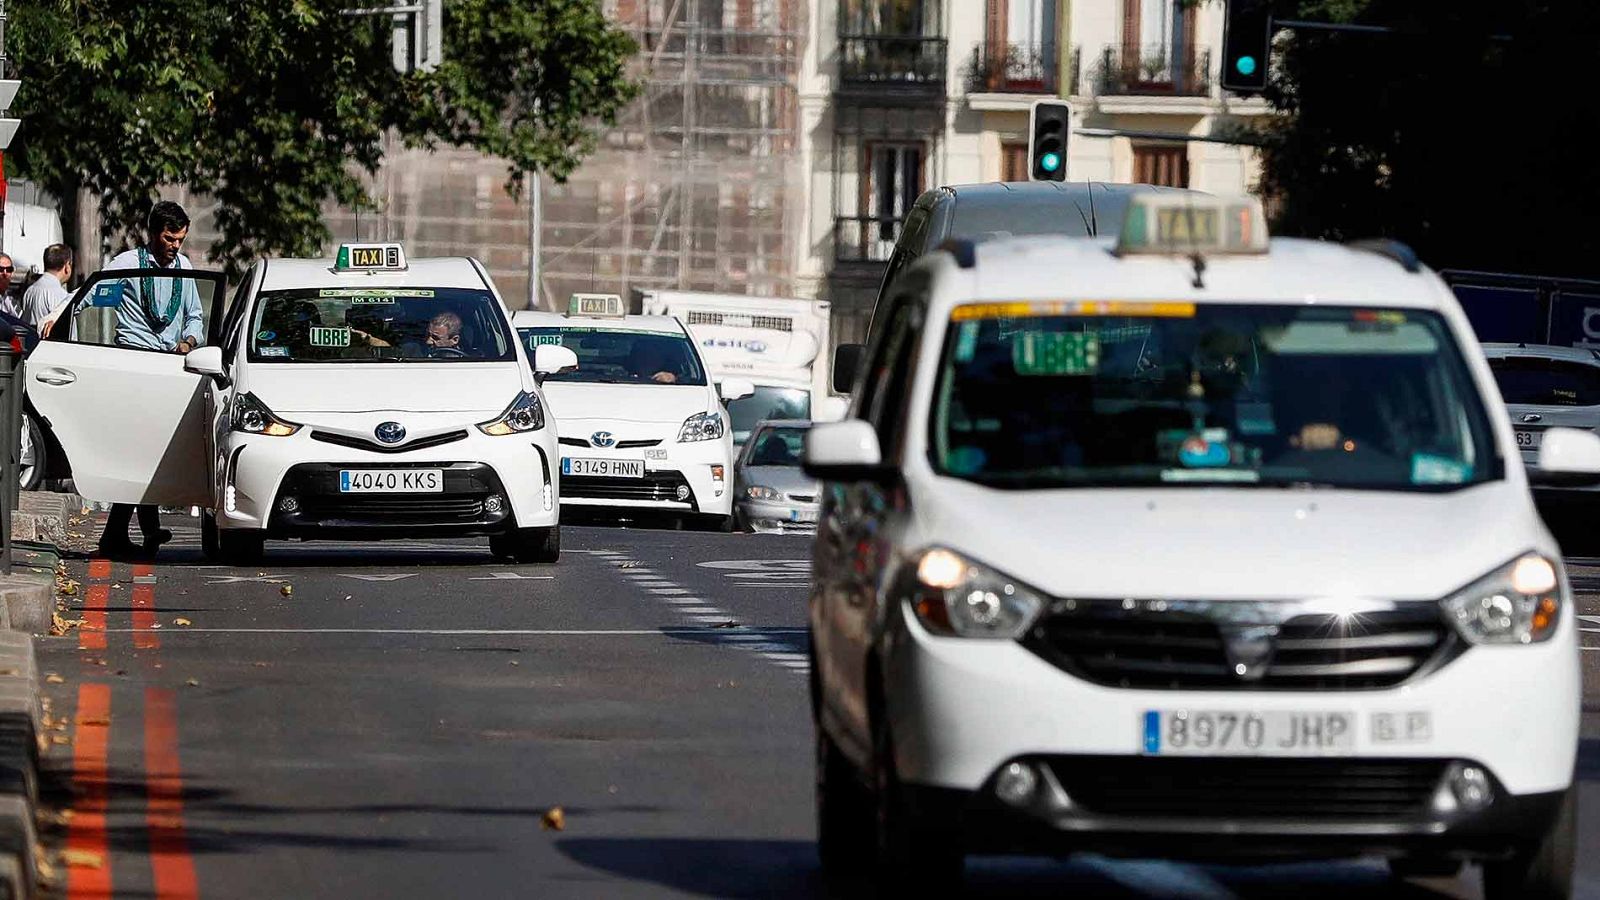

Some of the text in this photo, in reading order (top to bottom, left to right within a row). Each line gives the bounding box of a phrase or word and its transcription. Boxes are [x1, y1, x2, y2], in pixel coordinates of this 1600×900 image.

[353, 250, 383, 265] TAXI
[582, 299, 605, 312] TAXI
[311, 328, 348, 346] LIBRE
[574, 460, 639, 475] 3149 HNN
[352, 473, 437, 489] 4040 KKS
[1167, 709, 1265, 749] 8970
[1277, 710, 1348, 748] JHP
